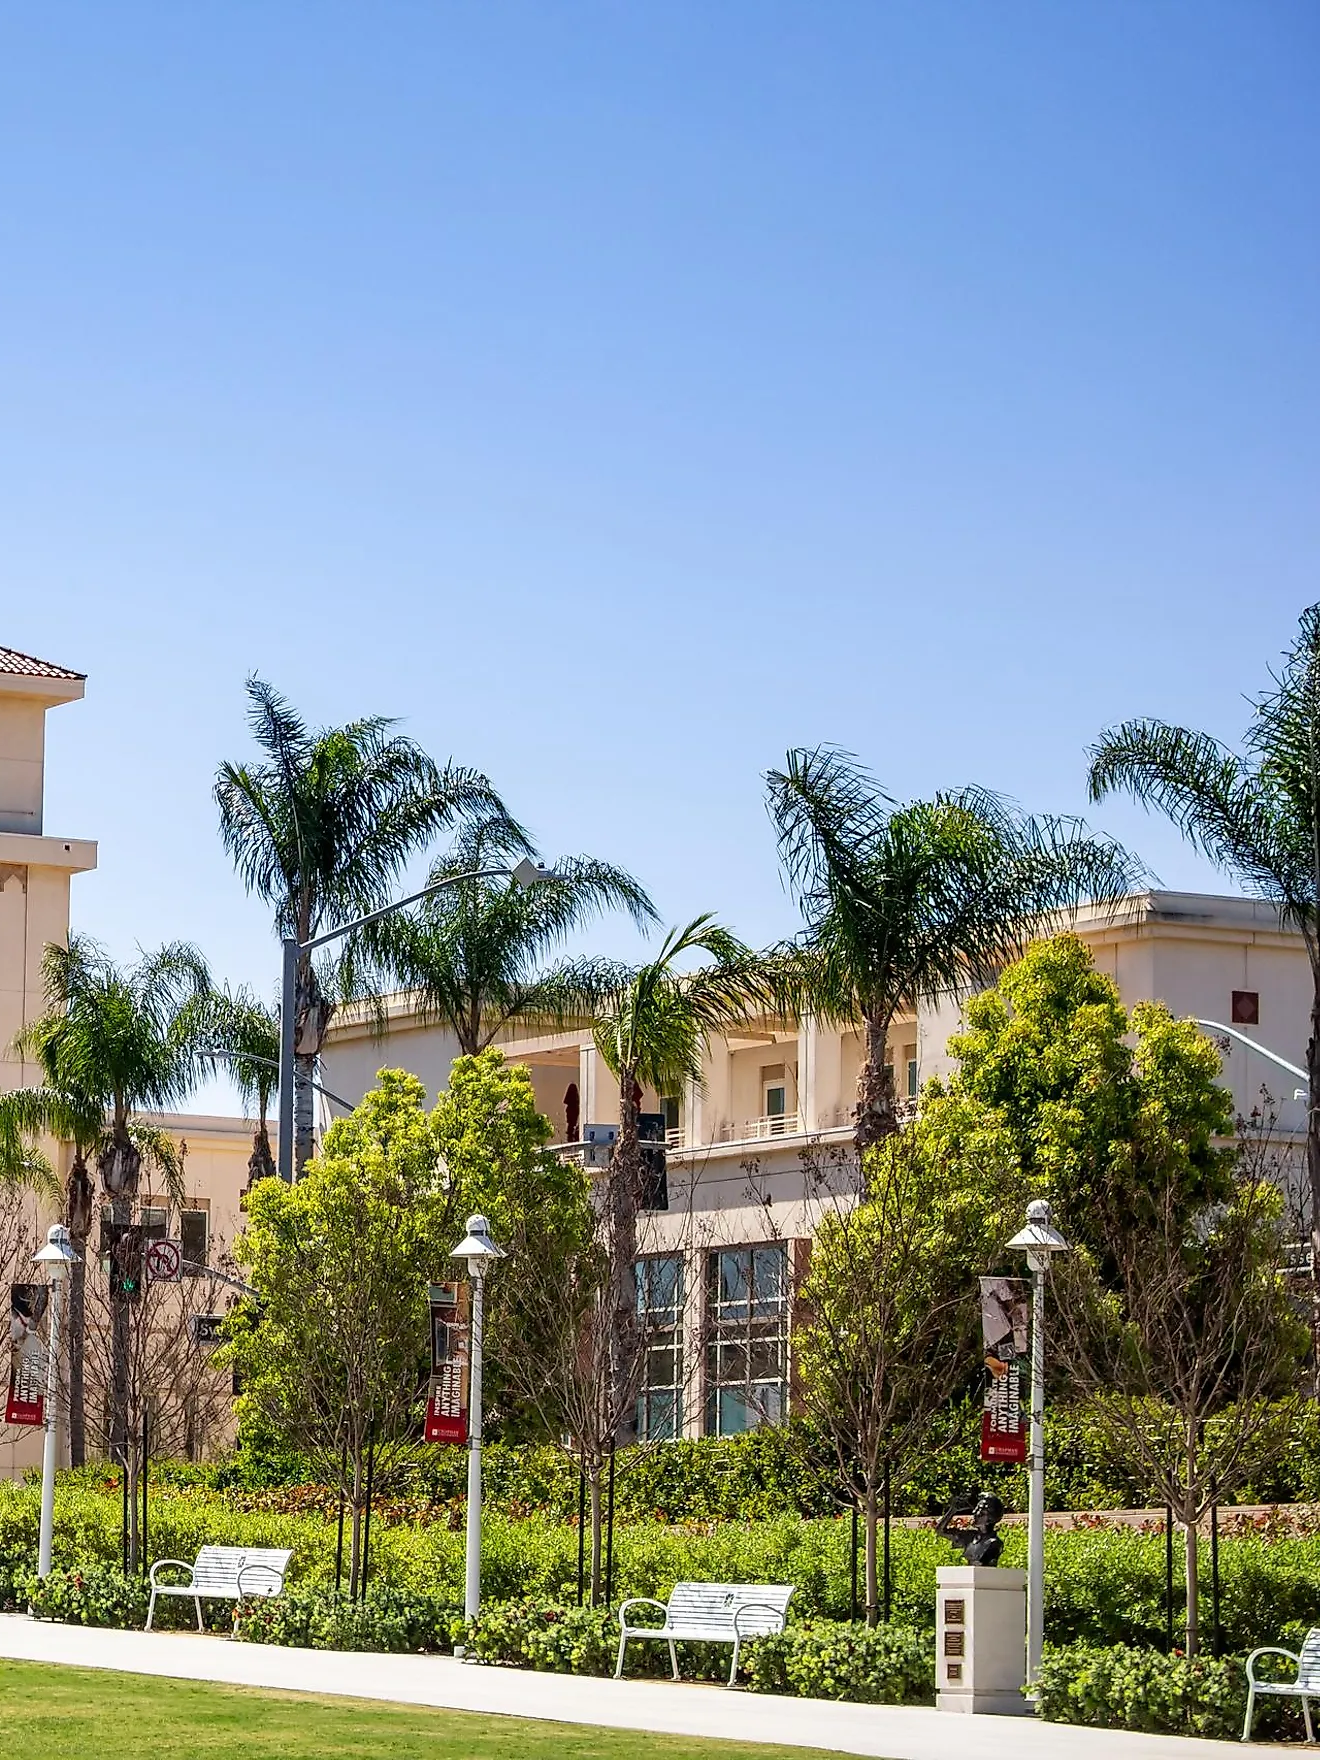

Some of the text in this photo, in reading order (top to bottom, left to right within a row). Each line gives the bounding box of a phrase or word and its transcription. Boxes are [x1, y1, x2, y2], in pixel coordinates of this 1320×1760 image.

[20, 1357, 30, 1403] ANYTHING
[434, 1385, 442, 1416] INSPIRE
[440, 1365, 451, 1417] ANYTHING
[450, 1357, 461, 1418] IMAGINABLE
[989, 1378, 998, 1432] FORMULATE
[998, 1374, 1008, 1433] ANYTHING
[1008, 1364, 1020, 1434] IMAGINABLE
